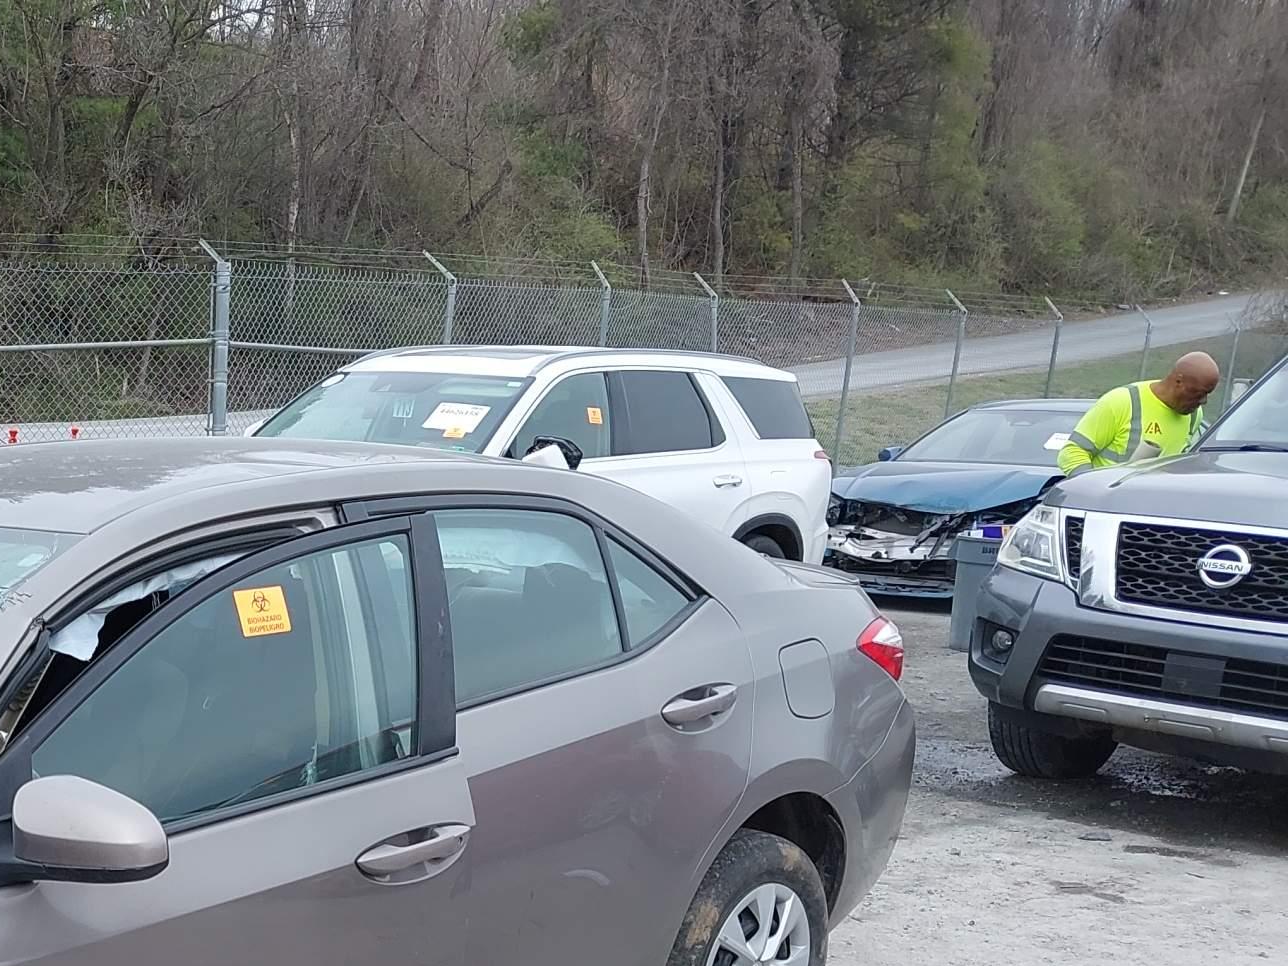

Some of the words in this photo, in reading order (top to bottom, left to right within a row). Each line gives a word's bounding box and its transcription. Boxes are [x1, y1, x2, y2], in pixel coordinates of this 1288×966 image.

[1201, 561, 1244, 572] NISSAN
[247, 614, 283, 625] BIOHAZARD
[249, 623, 285, 634] BIOPELIGRO
